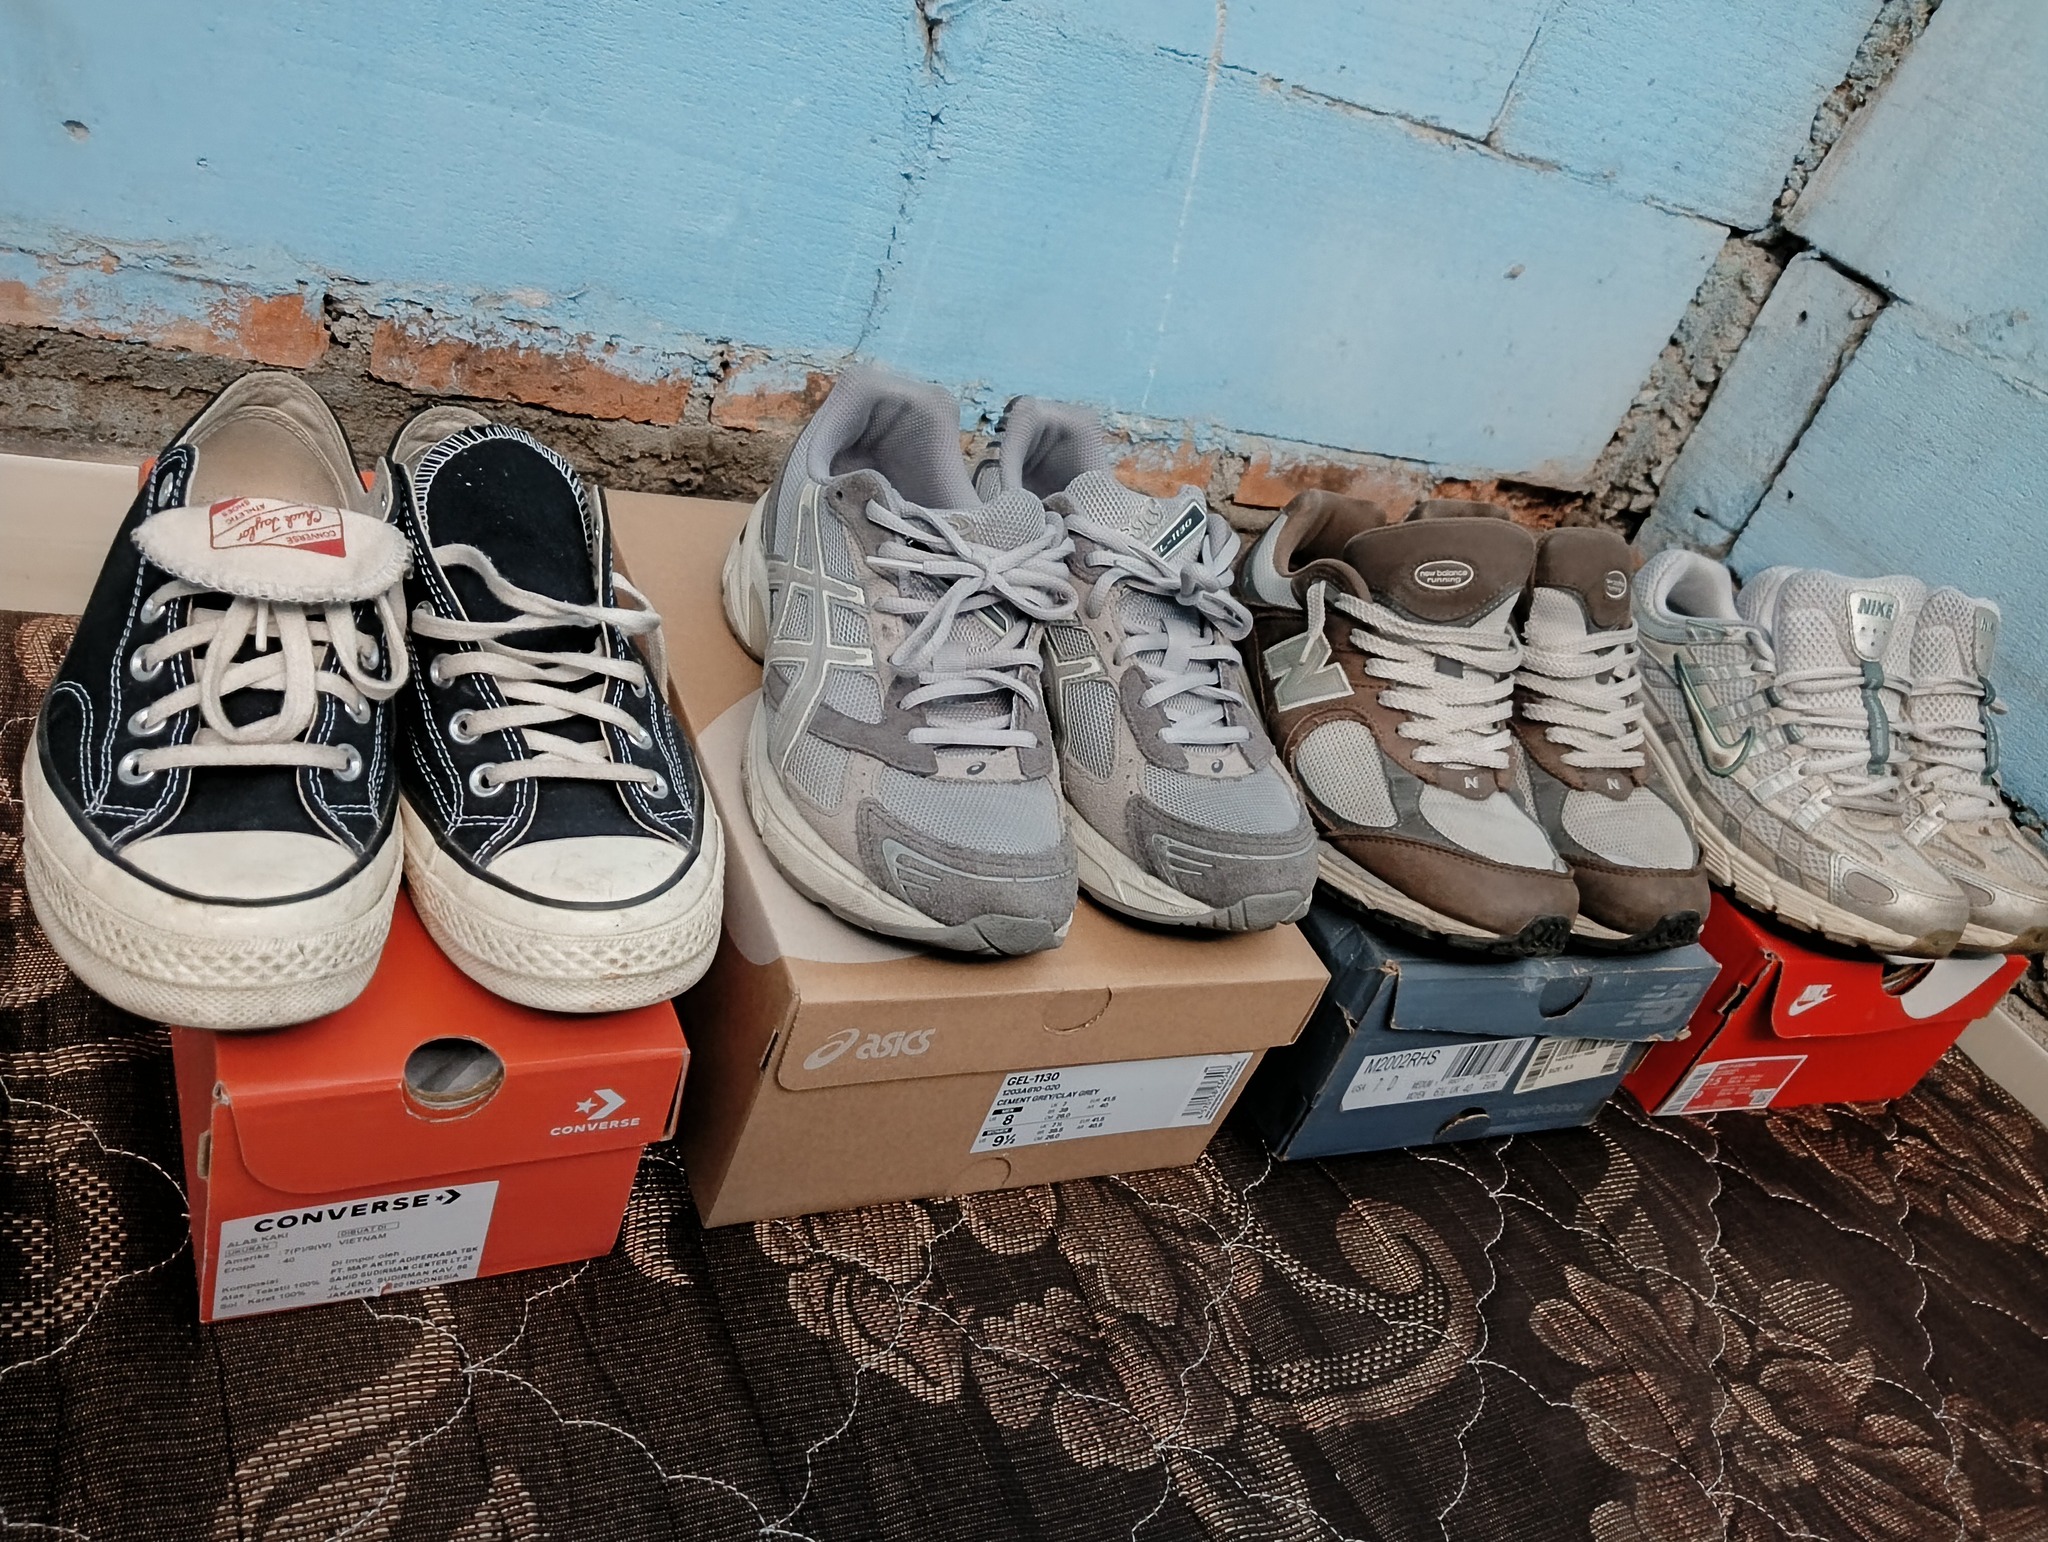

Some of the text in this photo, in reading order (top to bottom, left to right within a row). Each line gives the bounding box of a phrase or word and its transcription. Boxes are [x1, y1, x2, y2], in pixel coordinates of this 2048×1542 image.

[221, 500, 250, 518] SHOES
[225, 503, 265, 525] ATHLETIC
[236, 509, 322, 542] Chuck Taylor
[285, 530, 336, 544] CONVERSE
[1158, 517, 1193, 553] L-1130
[1427, 576, 1462, 585] running
[1437, 569, 1468, 577] balance
[1857, 597, 1895, 620] NIKE
[1464, 776, 1479, 789] N
[1606, 778, 1621, 790] N
[855, 1028, 937, 1060] asics
[1364, 1050, 1440, 1074] M2002RHS
[1007, 1072, 1060, 1086] GEL-1130
[996, 1088, 1100, 1106] CEMENT GREY/CLAY GREY
[1003, 1084, 1061, 1096] 1203A610-020
[550, 1117, 640, 1136] CONVERSE
[1002, 1114, 1014, 1126] 8
[253, 1192, 432, 1233] CONVERSE
[226, 1232, 289, 1248] ALAS KAKI
[339, 1232, 387, 1246] VIETNAM
[224, 1253, 270, 1265] Amerika
[347, 1263, 368, 1272] MAP
[370, 1259, 397, 1268] AKTIF
[399, 1250, 458, 1263] ADIPERKASA
[378, 1251, 400, 1260] oleh
[224, 1256, 295, 1274] Eropa 40
[329, 1273, 358, 1282] SAHID
[360, 1264, 409, 1277] SUDIRMAN
[411, 1259, 448, 1270] CENTER
[326, 1287, 374, 1298] JAKARTA
[406, 1272, 459, 1286] INDONESIA
[377, 1270, 430, 1283] SUDIRMAN
[220, 1293, 244, 1301] Alas
[294, 1280, 320, 1290] 100%
[221, 1278, 279, 1293] Komposisi
[247, 1296, 276, 1305] Karet
[279, 1291, 306, 1299] 100%
